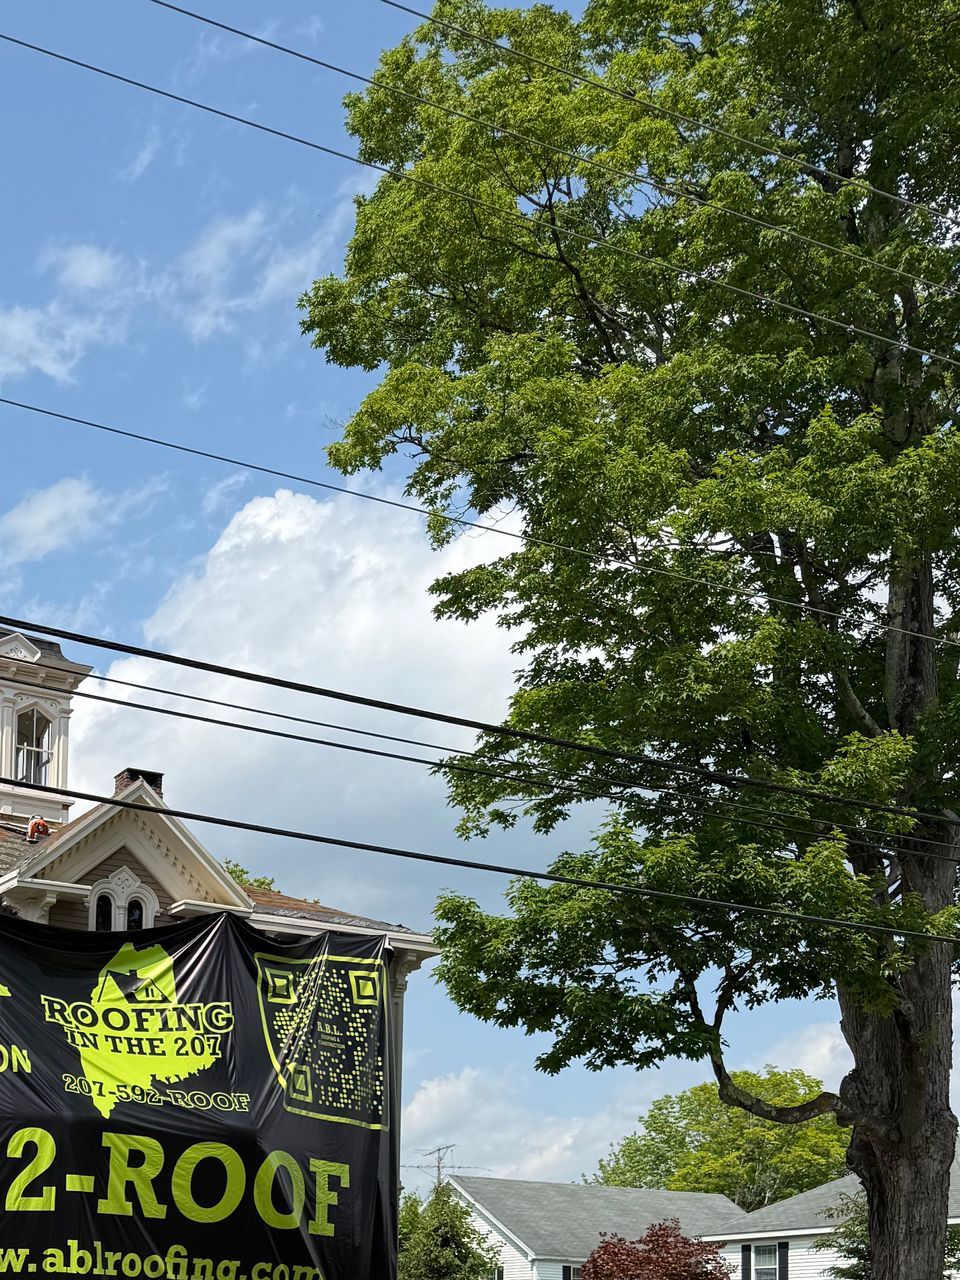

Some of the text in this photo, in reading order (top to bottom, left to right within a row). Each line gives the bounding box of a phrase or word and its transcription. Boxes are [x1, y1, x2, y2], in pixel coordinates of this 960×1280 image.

[40, 994, 235, 1034] ROOFING
[64, 1026, 222, 1058] IN THE 207
[61, 1073, 251, 1112] 207-592-ROOF
